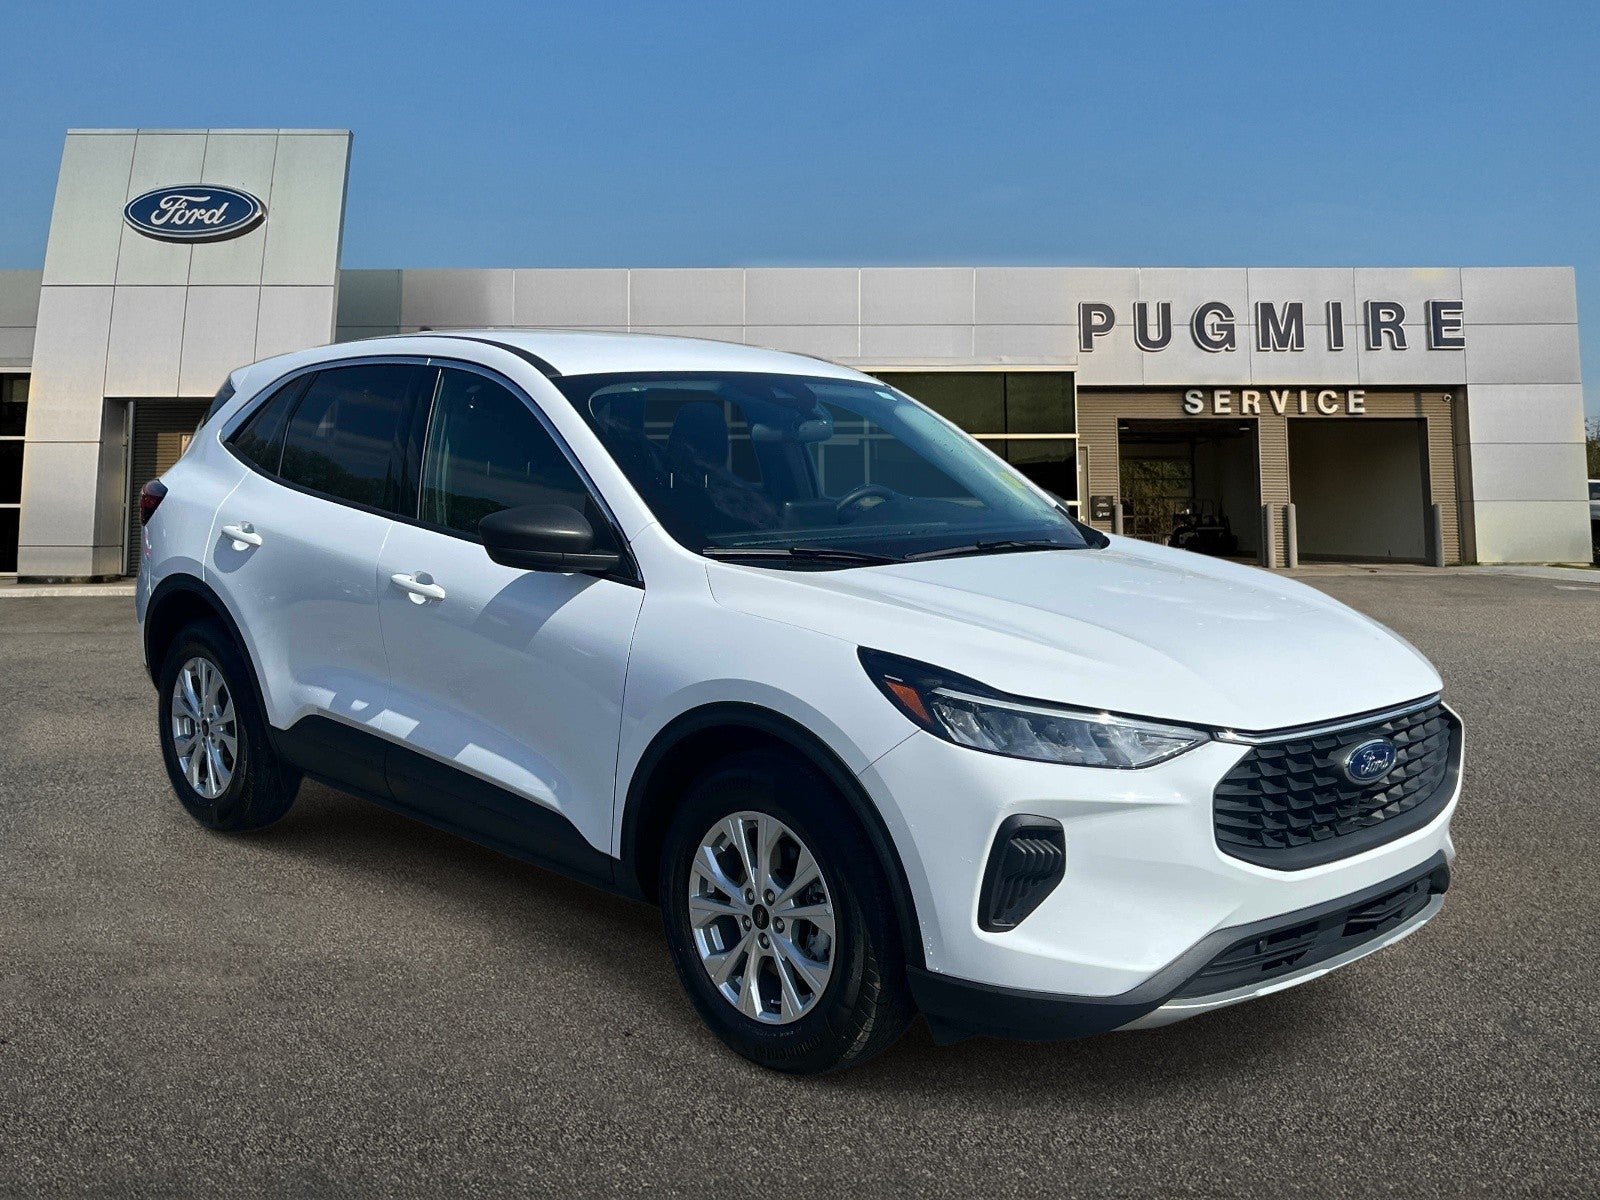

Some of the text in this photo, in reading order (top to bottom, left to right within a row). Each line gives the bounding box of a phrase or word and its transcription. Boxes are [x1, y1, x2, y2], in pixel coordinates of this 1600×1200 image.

[150, 195, 230, 225] Ford
[1078, 300, 1466, 353] PUGMIRE
[1184, 389, 1366, 415] SERVICE
[1360, 750, 1389, 776] Ford
